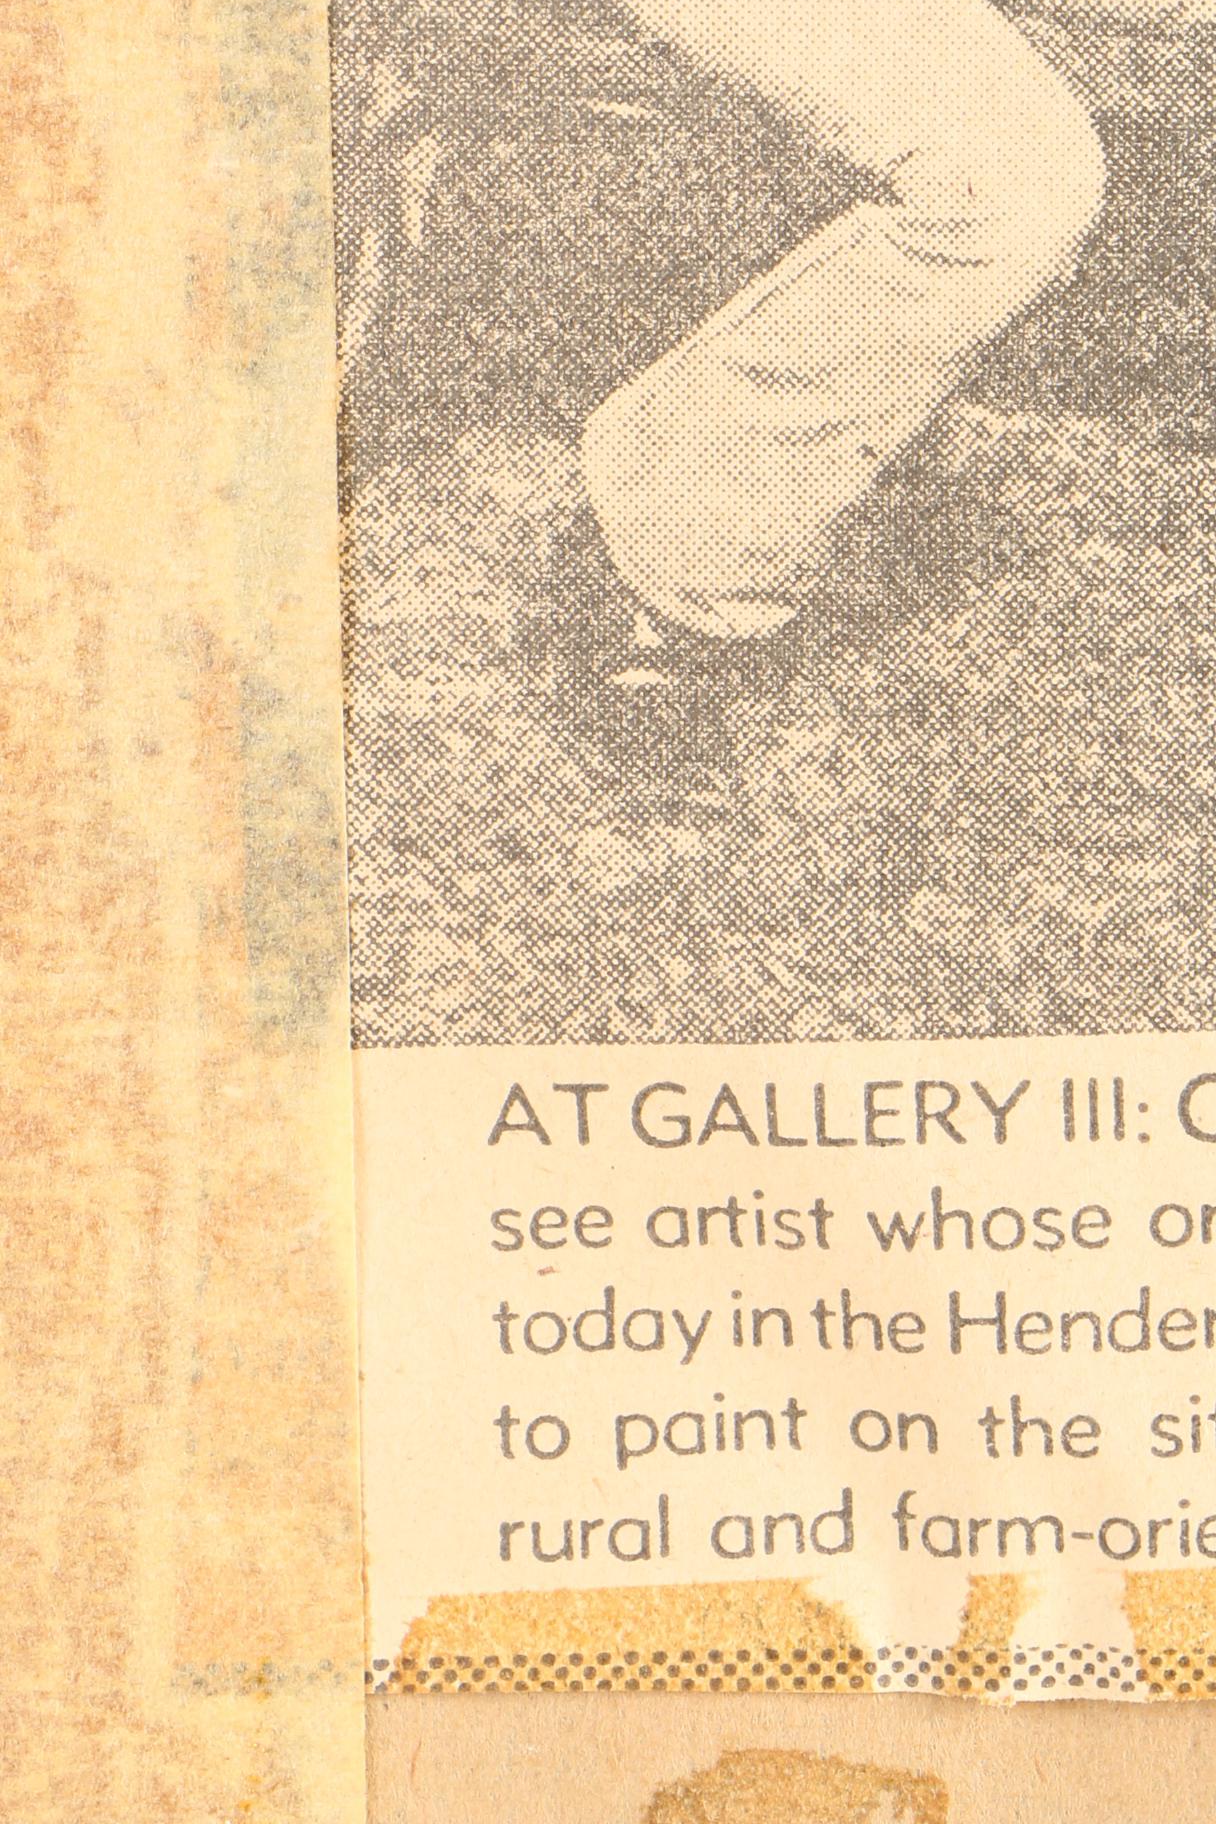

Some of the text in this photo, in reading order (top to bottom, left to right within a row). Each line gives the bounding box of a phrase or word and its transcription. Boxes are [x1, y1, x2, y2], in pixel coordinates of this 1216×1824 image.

[487, 1082, 609, 1146] AT
[631, 1079, 1031, 1149] GALLERY
[1062, 1076, 1150, 1144] III:
[490, 1205, 614, 1252] see
[646, 1189, 834, 1251] artist
[866, 1186, 1112, 1253] whose
[492, 1284, 713, 1365] today
[731, 1290, 794, 1347] in
[809, 1288, 926, 1354] the
[493, 1405, 571, 1460] to
[615, 1392, 808, 1471] paint
[849, 1409, 938, 1454] on
[978, 1394, 1102, 1459] the
[499, 1493, 670, 1563] rural
[710, 1486, 854, 1560] and
